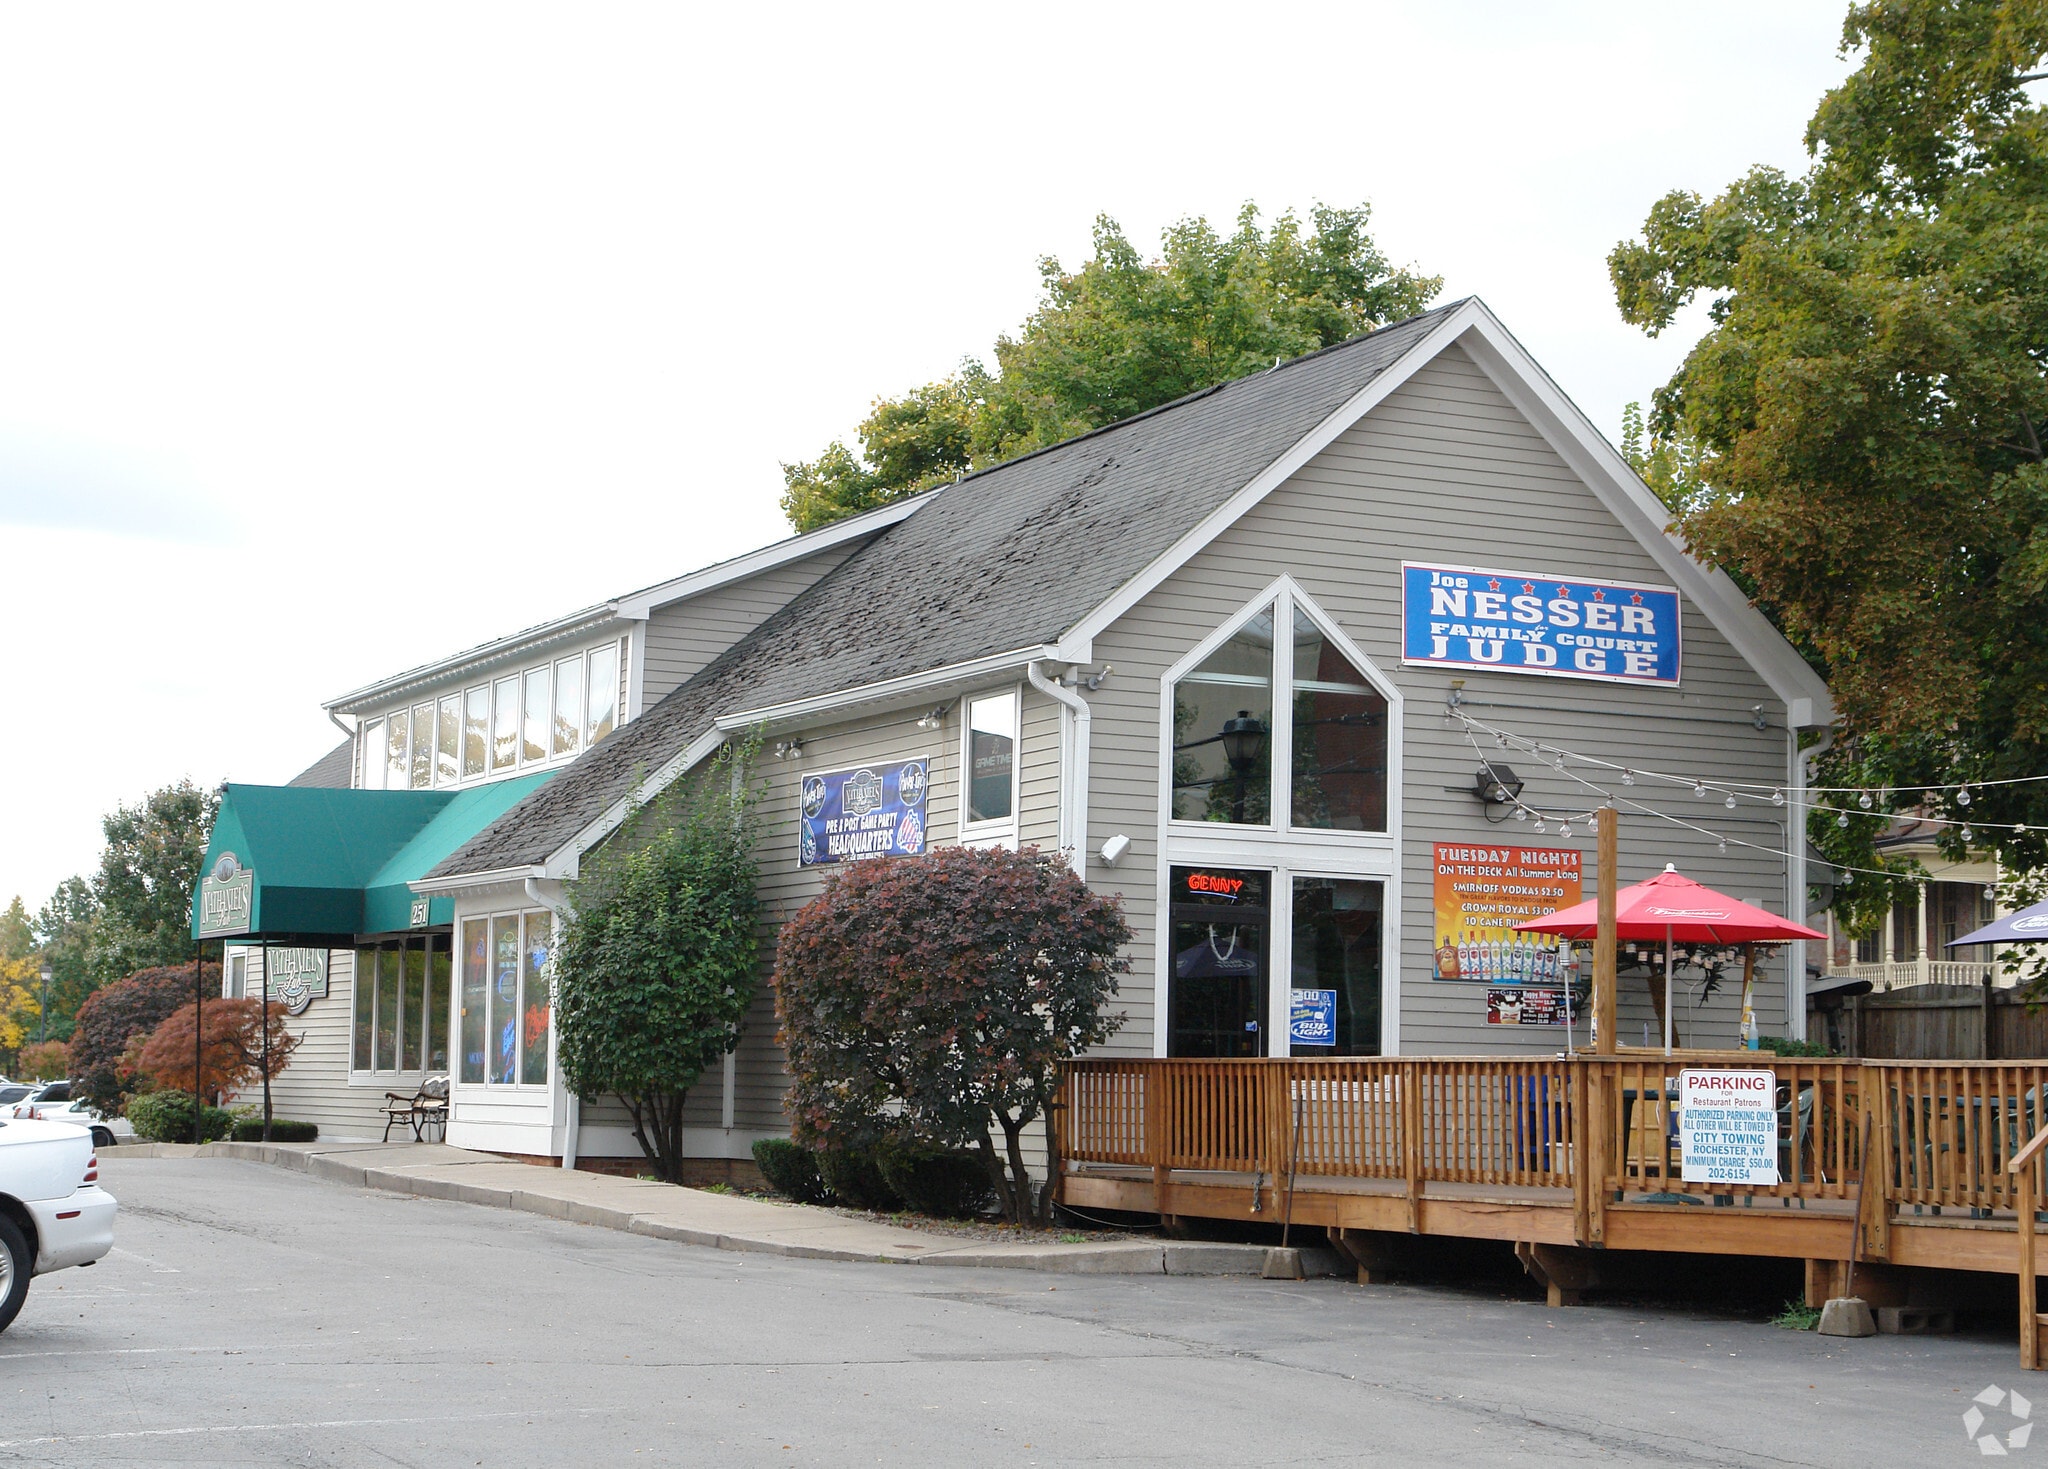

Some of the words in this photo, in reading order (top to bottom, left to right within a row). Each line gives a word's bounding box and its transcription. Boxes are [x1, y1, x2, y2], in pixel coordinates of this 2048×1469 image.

[1431, 572, 1468, 588] Joe
[1430, 587, 1656, 635] NESSER
[1430, 622, 1547, 642] FAMILY
[1556, 633, 1658, 653] COURT
[1429, 635, 1658, 677] JUDGE
[826, 819, 838, 834] PRE
[844, 817, 859, 832] POST
[861, 814, 878, 830] GAME
[878, 812, 898, 828] PARTY
[829, 829, 893, 855] HEADQUARTERS
[1438, 848, 1510, 863] TUESDAY
[1520, 851, 1578, 865] NIGHTS
[1438, 864, 1454, 875] ON
[1457, 865, 1476, 876] THE
[1478, 866, 1502, 877] DECK
[1520, 869, 1555, 879] Summer
[1557, 869, 1579, 882] Long
[1188, 874, 1242, 893] GENNY
[1453, 882, 1499, 893] SMIRNOFF
[1501, 885, 1539, 896] VODKAS
[1541, 886, 1564, 897] $2.50
[202, 883, 249, 925] NATHANIEL'S
[1461, 902, 1496, 912] CROWN
[1498, 903, 1529, 914] ROYAL
[412, 903, 427, 926] 251
[1465, 917, 1477, 925] 10
[1480, 917, 1503, 927] CANE
[1293, 1028, 1331, 1036] LIGHT
[1299, 1022, 1328, 1030] BUD
[1689, 1077, 1766, 1090] PARKING
[1693, 1097, 1731, 1106] Restaurant
[1735, 1098, 1761, 1107] Patrons
[1685, 1109, 1724, 1120] AUTHORIZED
[1726, 1110, 1755, 1121] PARKING
[1756, 1111, 1773, 1121] ONLY
[1684, 1120, 1695, 1130] ALL
[1696, 1120, 1717, 1130] OTHER
[1718, 1121, 1733, 1131] WILL
[1734, 1122, 1742, 1131] BE
[1744, 1122, 1765, 1132] TOWED
[1767, 1122, 1775, 1132] BY
[1693, 1132, 1718, 1143] CITY
[1722, 1133, 1765, 1144] TOWING
[1693, 1145, 1749, 1156] ROCHESTER,
[1752, 1147, 1765, 1156] NY
[1686, 1156, 1717, 1166] MINIMUM
[1719, 1157, 1745, 1168] CHARGE
[1749, 1158, 1773, 1169] $50.00
[1708, 1168, 1750, 1180] 202-6154
